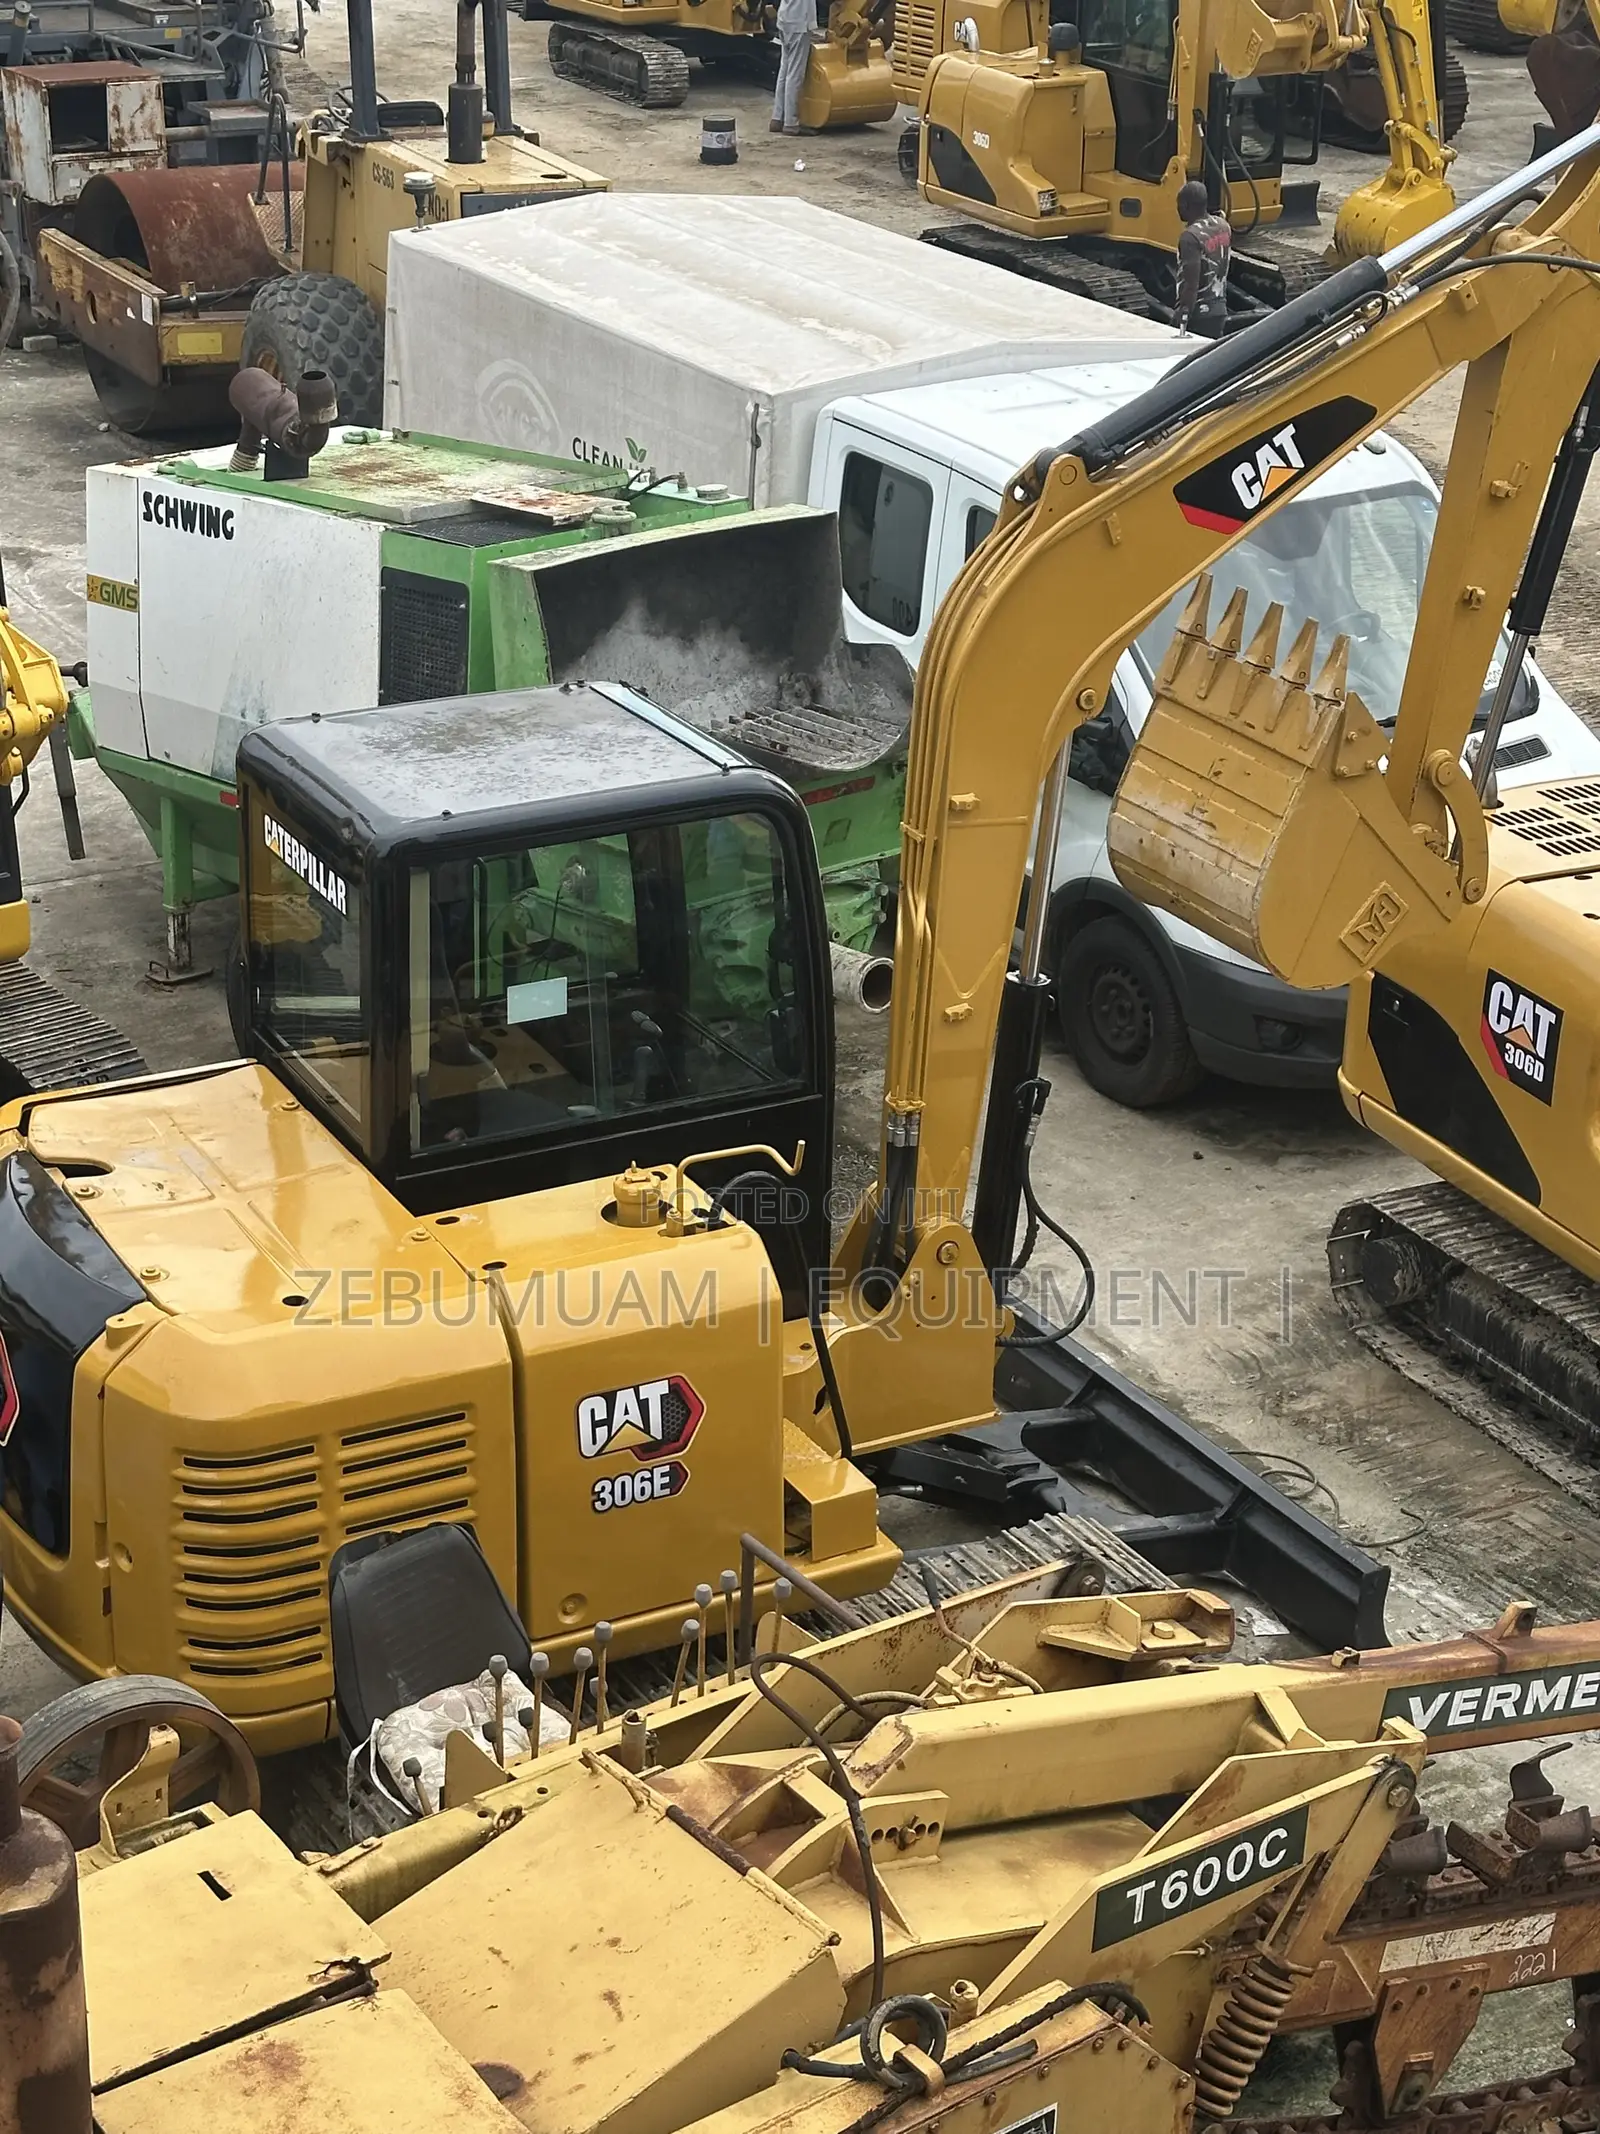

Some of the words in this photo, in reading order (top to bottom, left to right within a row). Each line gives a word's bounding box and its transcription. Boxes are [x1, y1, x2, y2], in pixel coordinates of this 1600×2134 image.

[372, 160, 395, 190] CS-563
[572, 436, 623, 470] CLEAN
[1231, 423, 1305, 510] CAT
[142, 490, 235, 541] SCHWING
[99, 581, 138, 610] GMS
[264, 813, 347, 916] CATERPILLAR
[1348, 890, 1402, 960] CAT
[1488, 981, 1557, 1060] CAT
[1504, 1042, 1545, 1083] 306D
[578, 1379, 670, 1457] CAT
[593, 1464, 671, 1511] 306E
[1126, 1827, 1289, 1925] T600C
